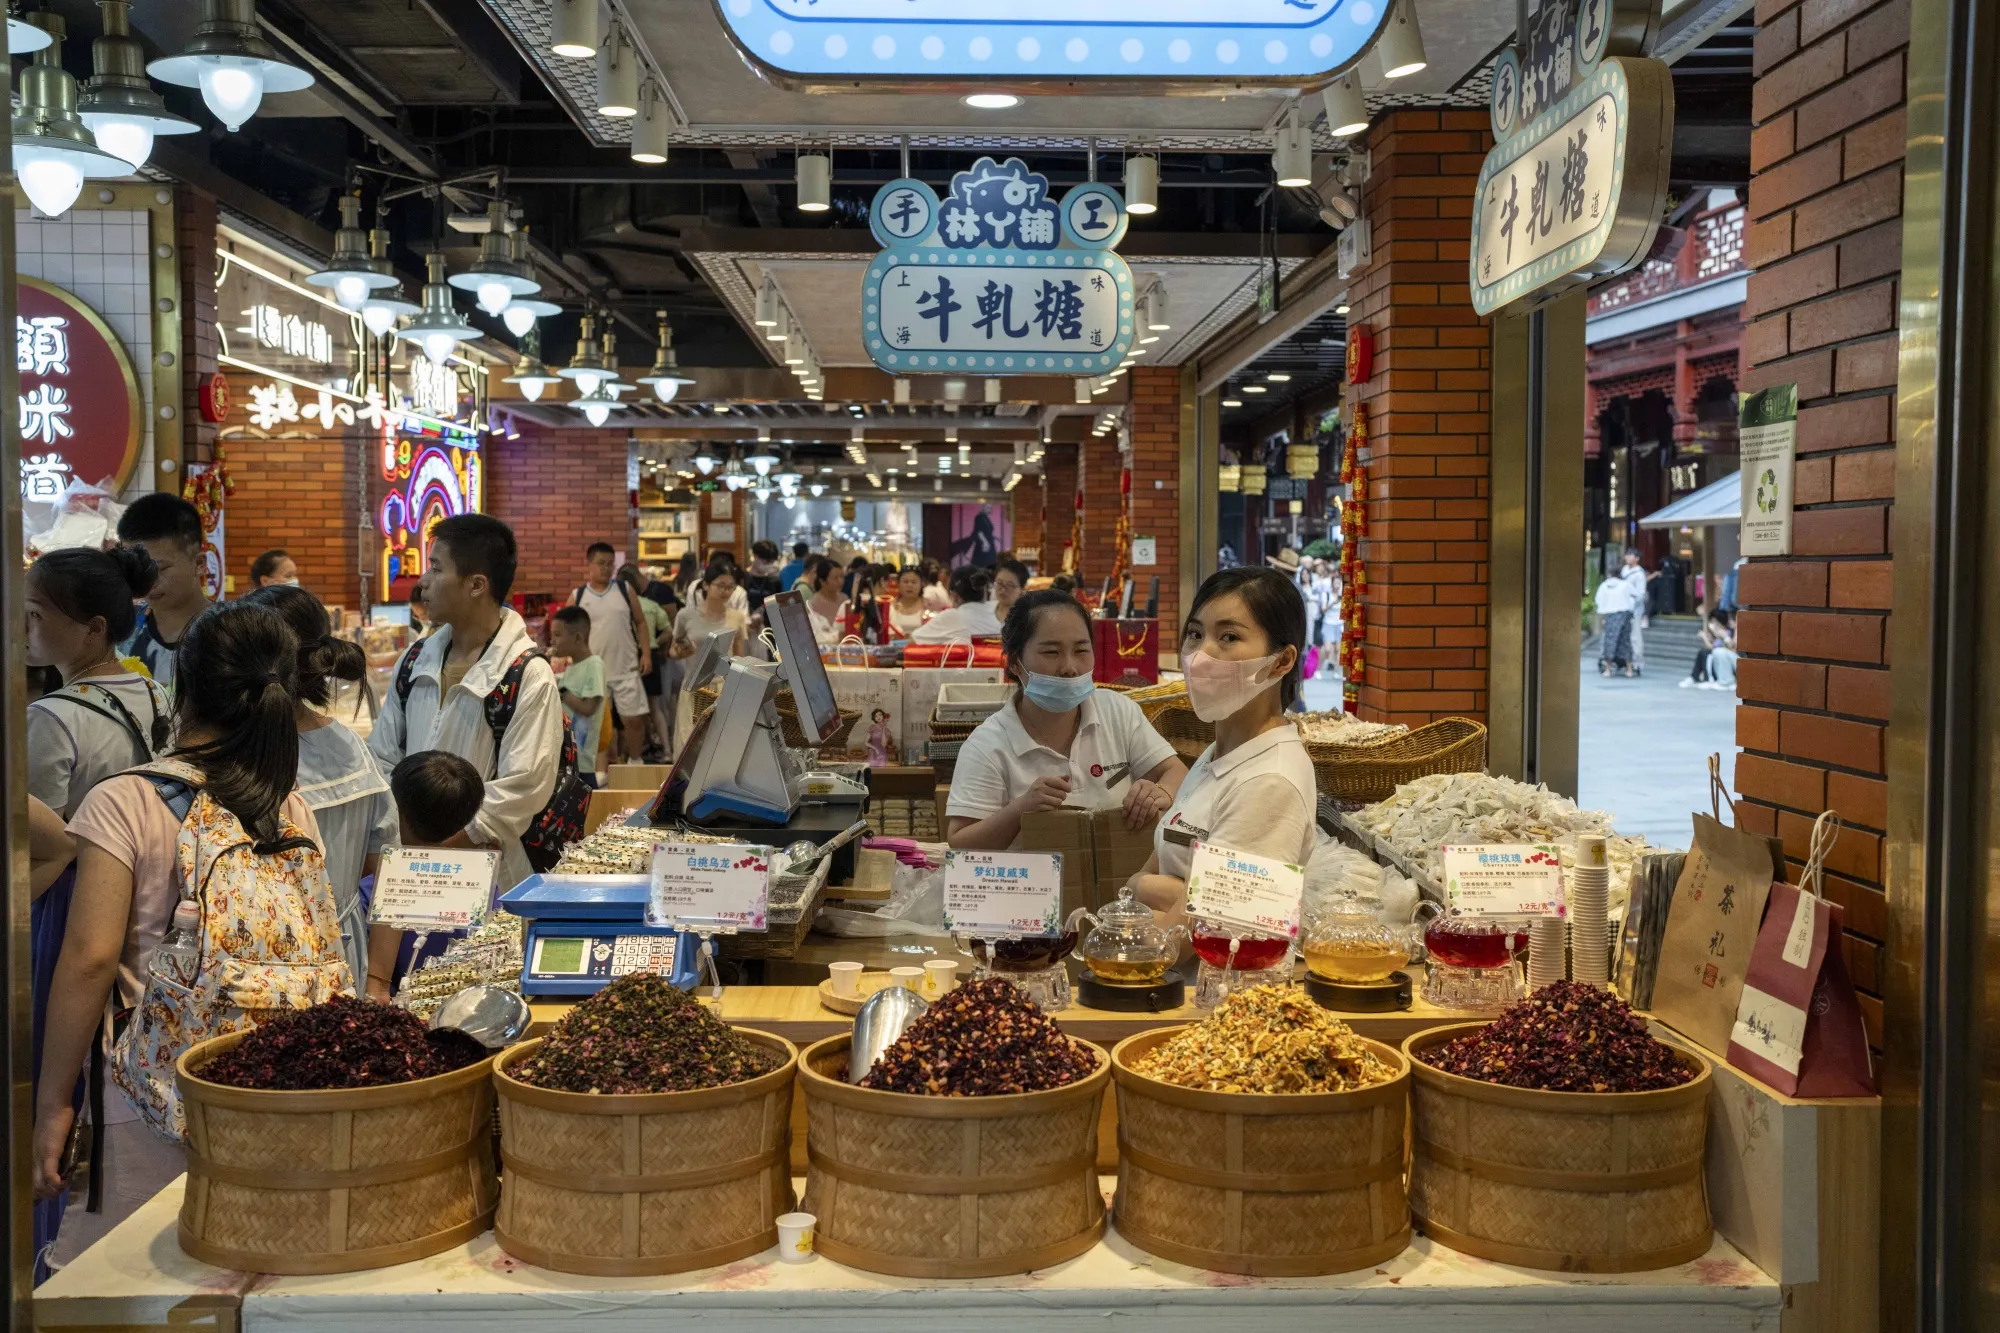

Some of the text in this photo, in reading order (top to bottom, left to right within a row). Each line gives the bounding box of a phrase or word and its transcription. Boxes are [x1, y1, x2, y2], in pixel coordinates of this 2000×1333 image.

[1500, 66, 1513, 124] 手
[1596, 104, 1608, 132] 味
[1590, 189, 1600, 219] 道
[889, 193, 921, 233] 手
[1081, 198, 1109, 231] 工
[1091, 275, 1105, 293] 味
[1090, 329, 1104, 347] 道
[687, 856, 730, 869] 白桃乌龙
[1479, 853, 1522, 863] 樱桃玫瑰
[409, 862, 463, 874] 朗姆覆盆子
[974, 866, 1029, 878] 梦幻夏威夷
[1227, 859, 1269, 876] 西柚甜心
[1519, 902, 1549, 911] 1.2元/克
[439, 911, 468, 920] 1.2元/克
[717, 911, 747, 921] 1.2元/克
[1256, 915, 1284, 927] 1.2元/克
[1011, 918, 1041, 927] 1.2元/克
[630, 936, 638, 944] 8
[642, 936, 650, 944] 9
